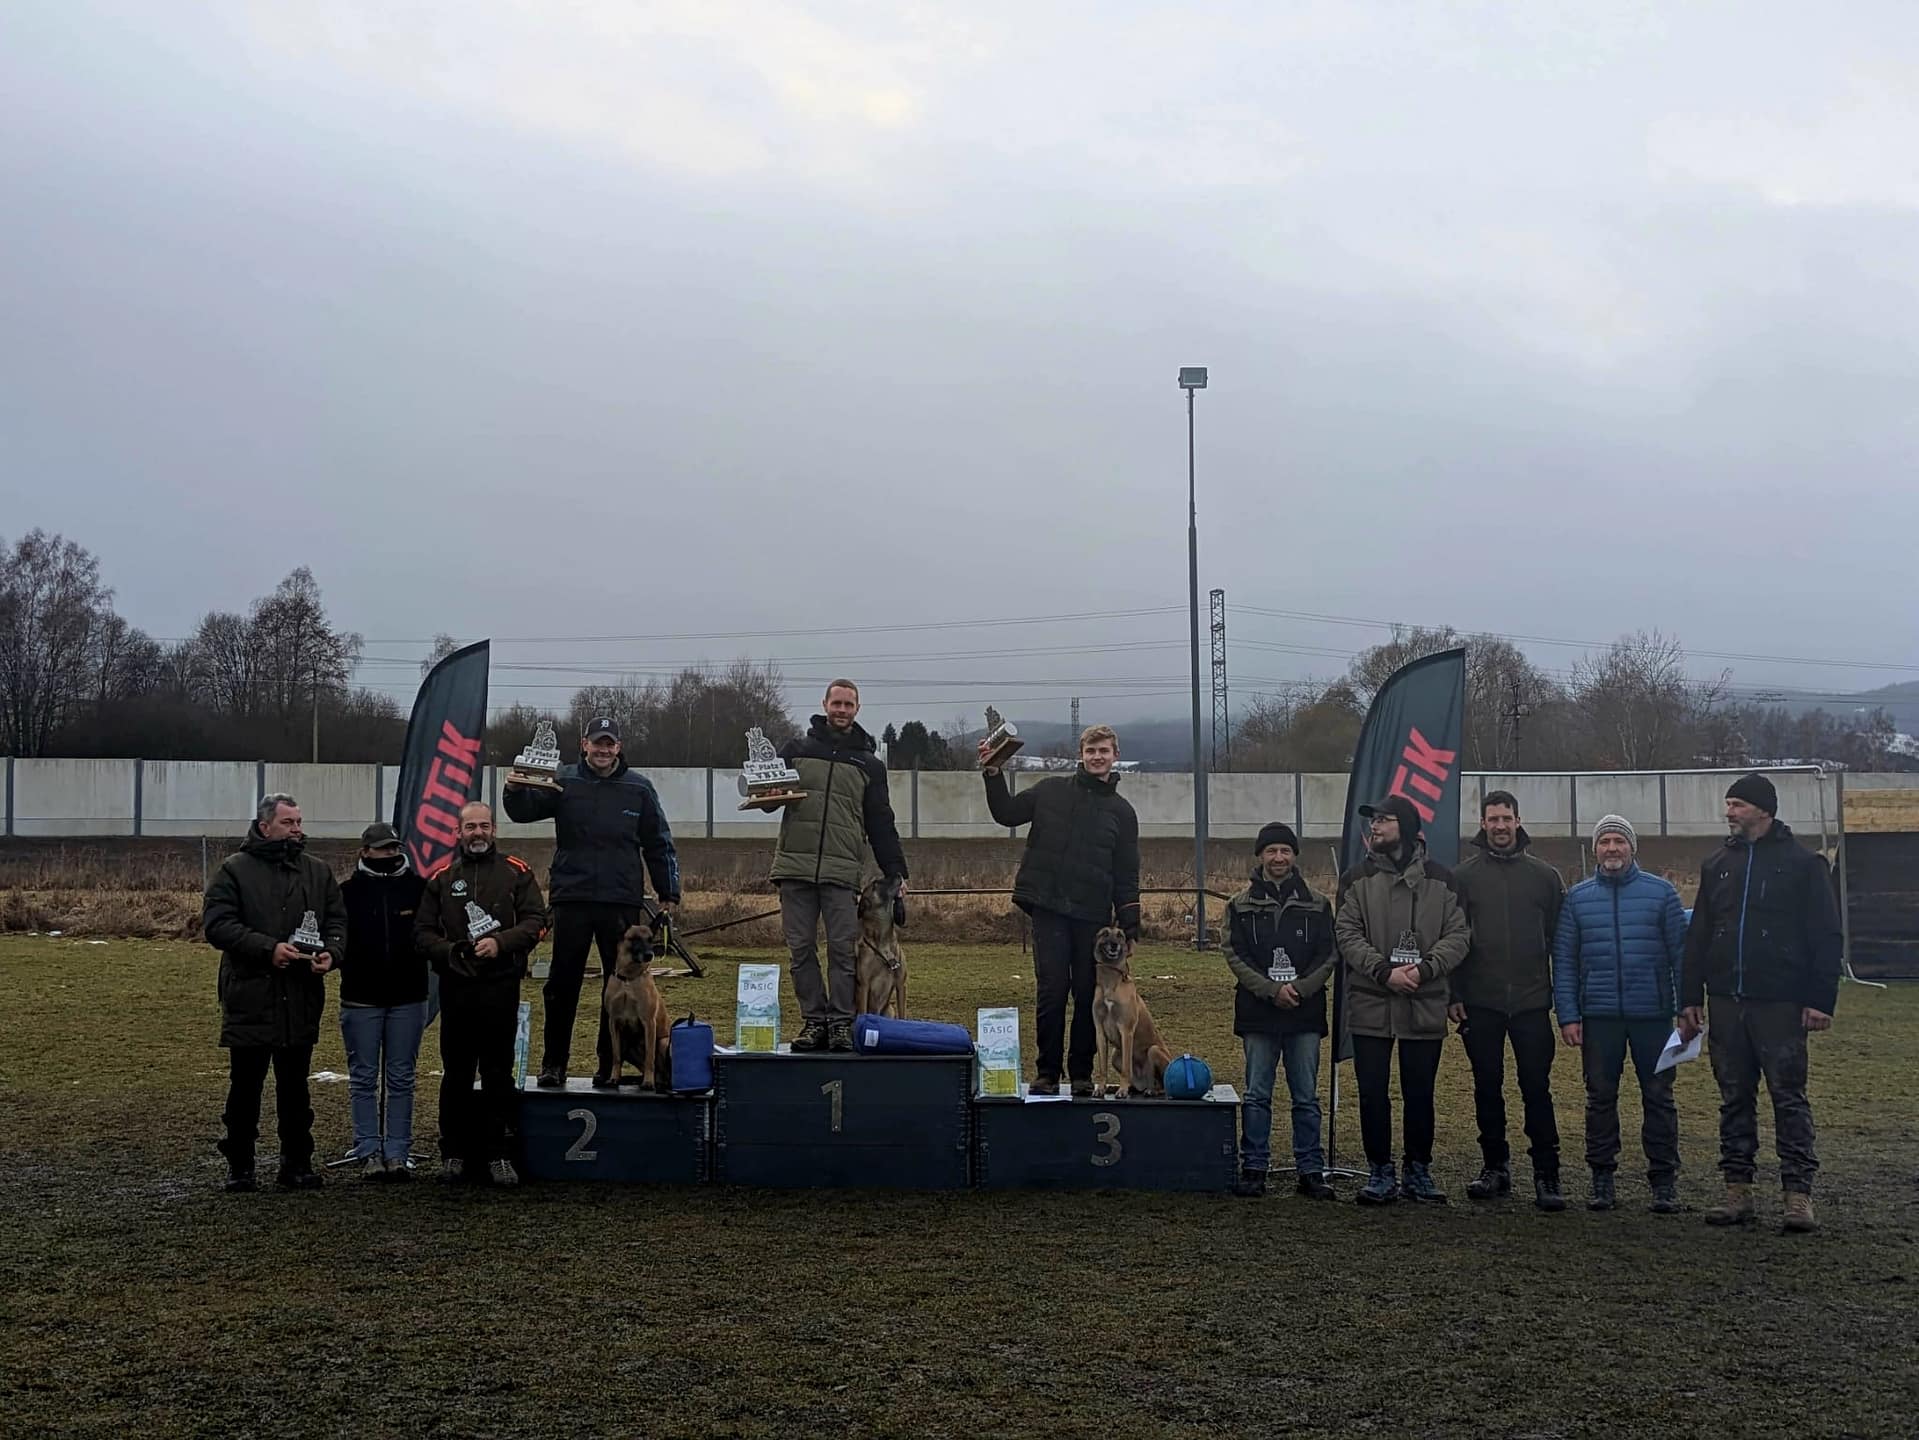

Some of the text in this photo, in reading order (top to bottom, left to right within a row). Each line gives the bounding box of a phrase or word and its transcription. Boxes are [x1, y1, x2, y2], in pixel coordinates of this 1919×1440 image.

[743, 982, 774, 991] BASIC
[983, 1025, 1013, 1034] BASIC
[820, 1080, 842, 1132] 1
[565, 1108, 598, 1160] 2
[1090, 1112, 1122, 1167] 3
